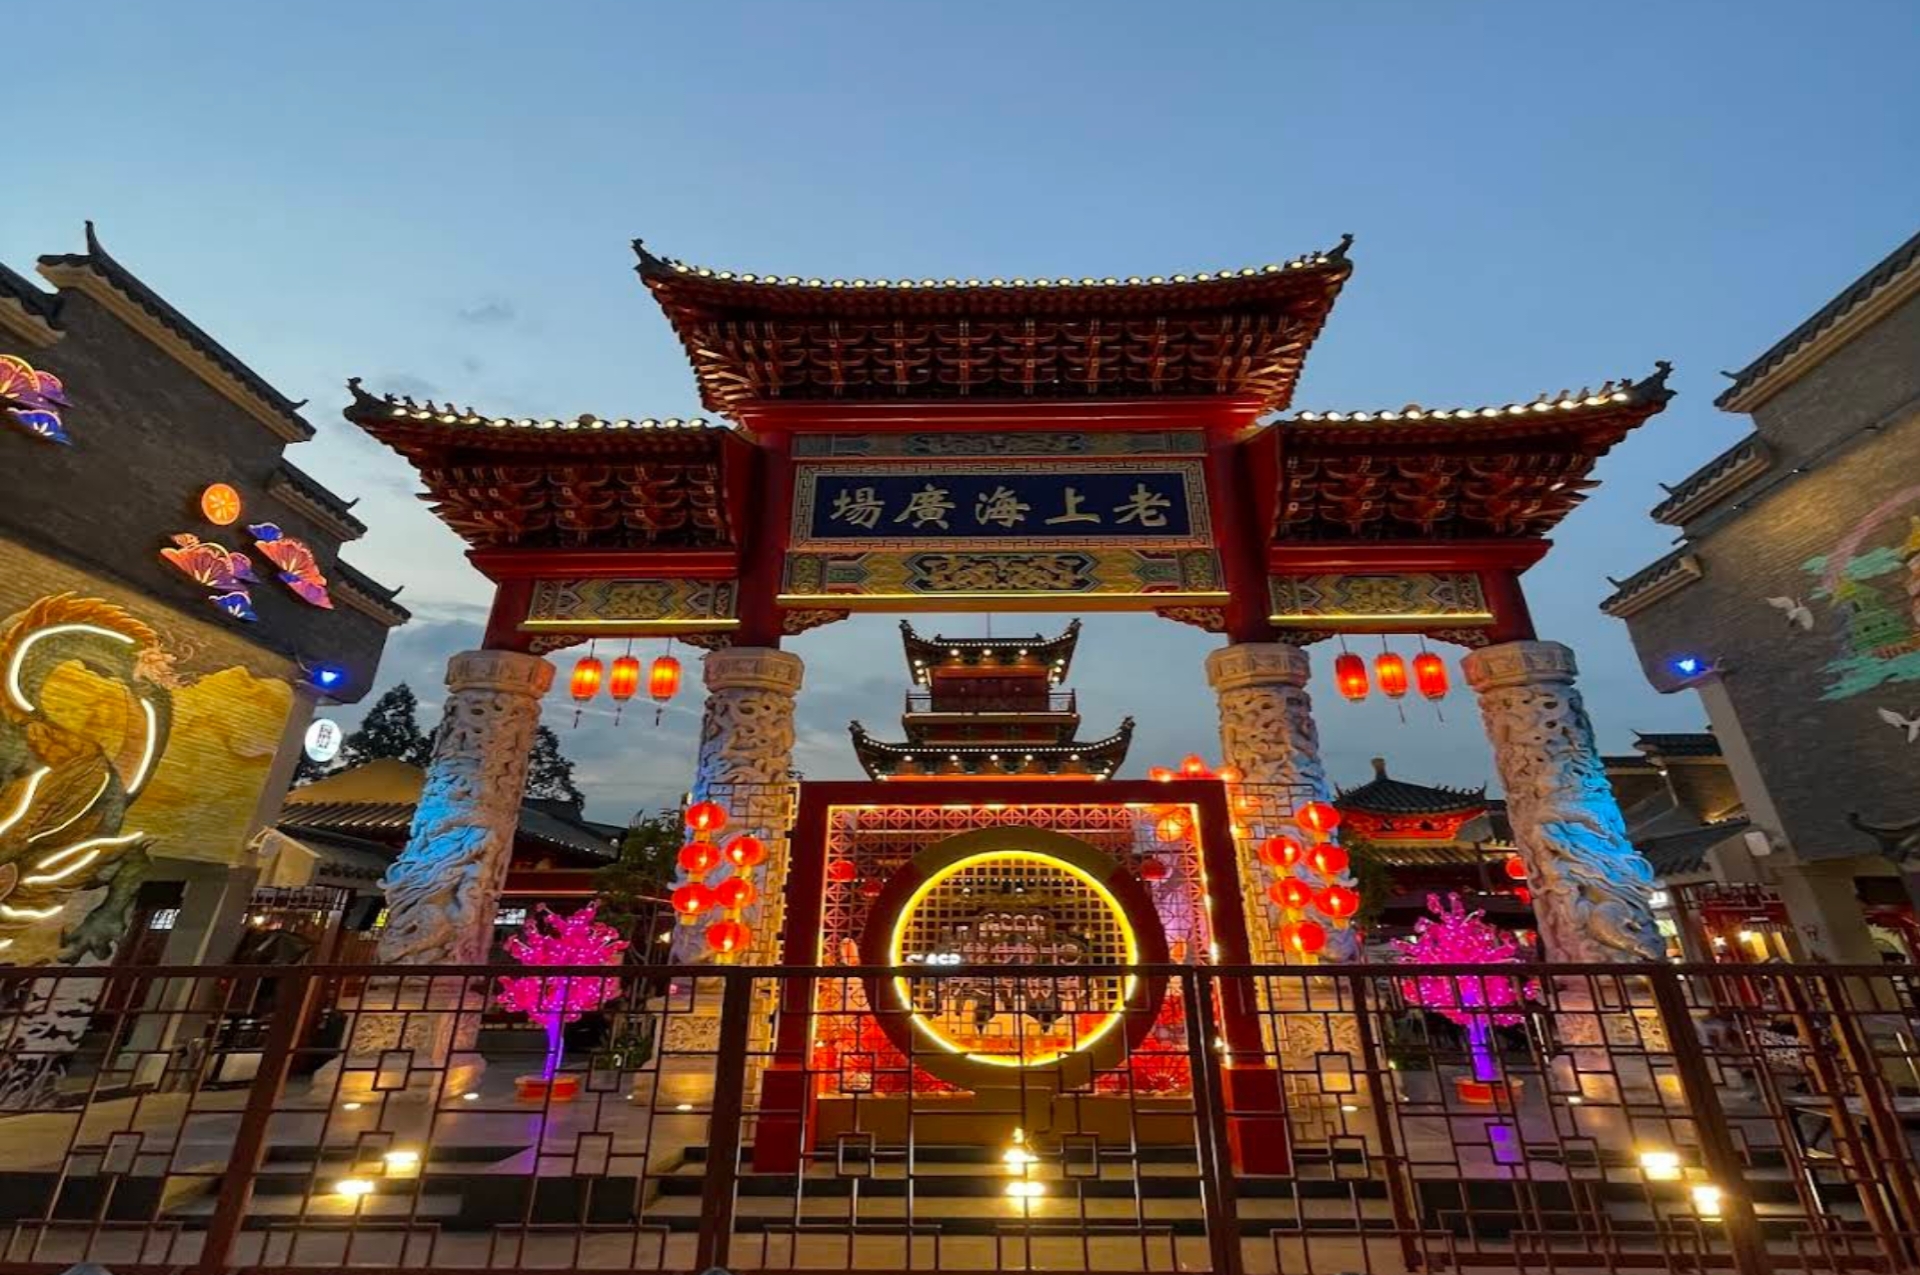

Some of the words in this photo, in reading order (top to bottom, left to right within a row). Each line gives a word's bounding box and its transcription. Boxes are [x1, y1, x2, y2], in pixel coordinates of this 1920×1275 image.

[829, 483, 1171, 530] 老上海廣場
